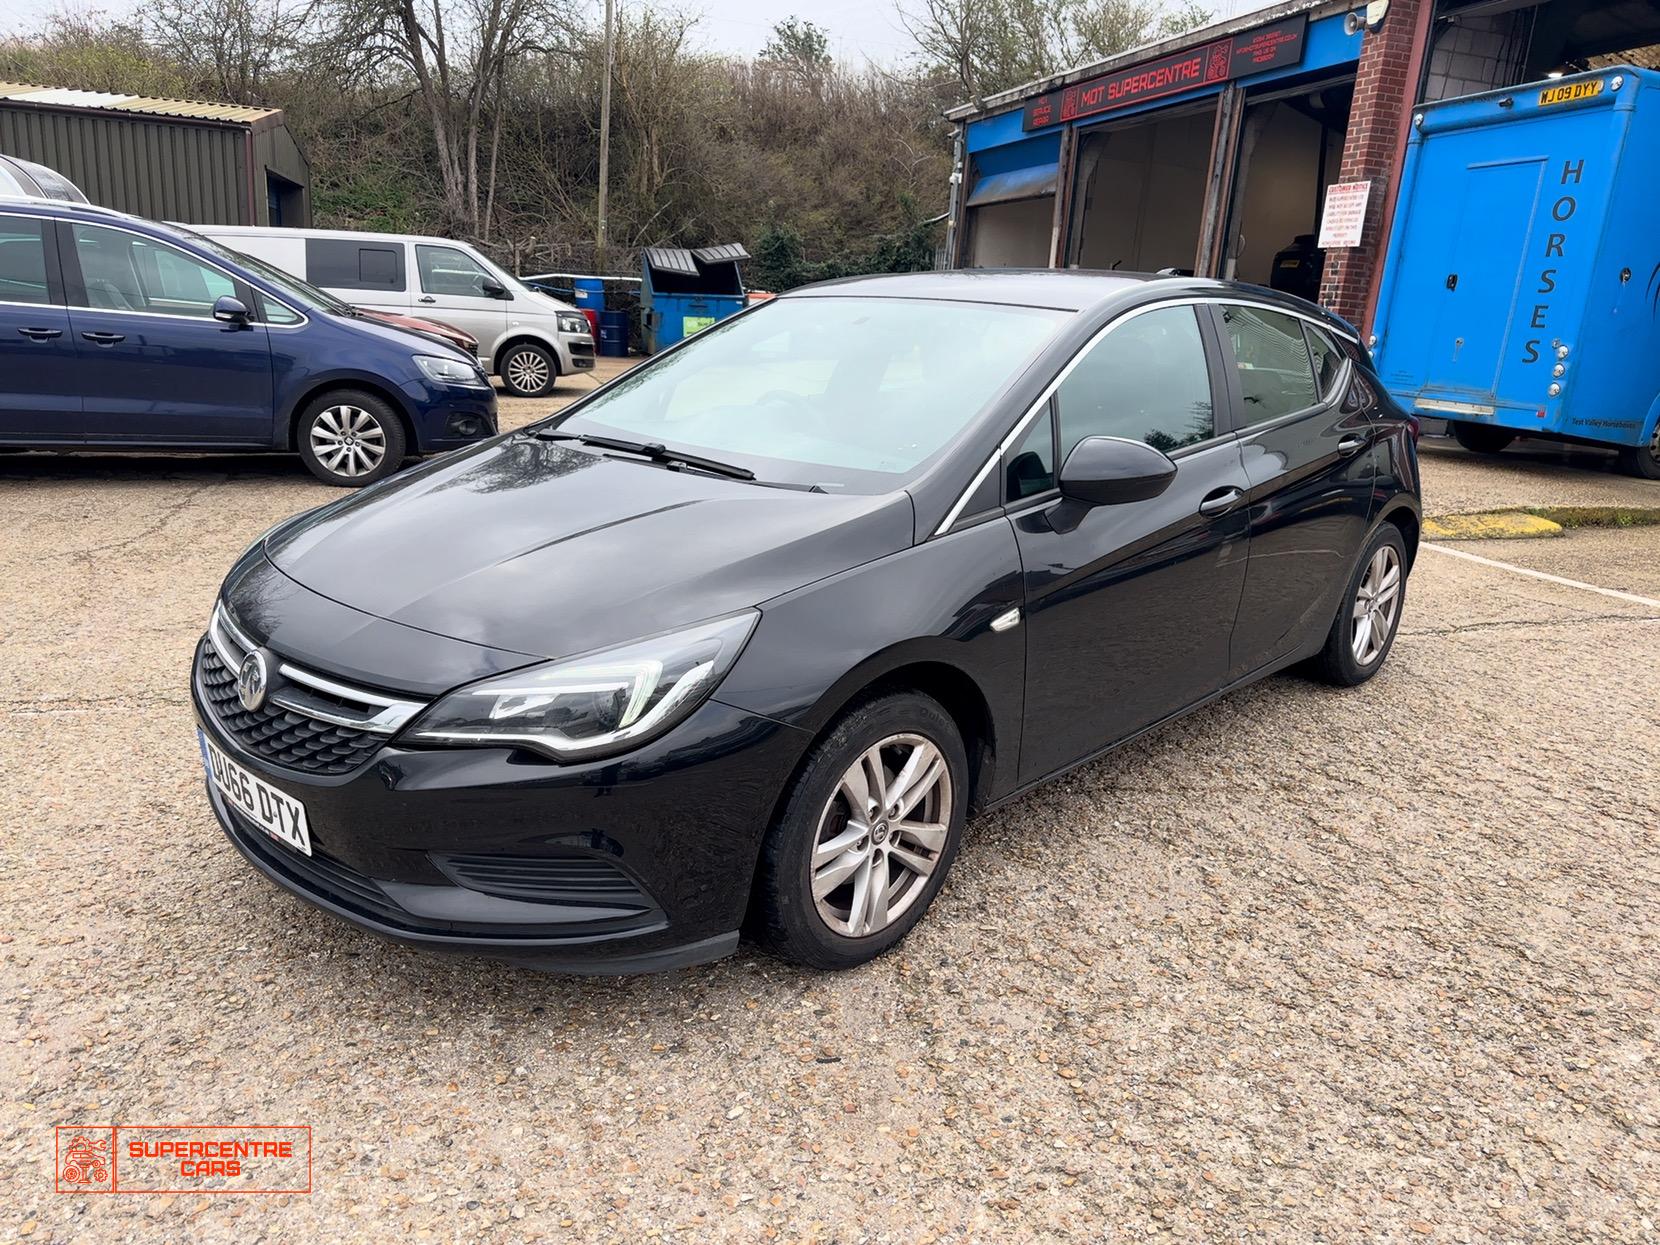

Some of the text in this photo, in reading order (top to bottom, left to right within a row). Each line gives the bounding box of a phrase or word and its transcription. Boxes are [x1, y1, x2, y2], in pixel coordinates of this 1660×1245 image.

[1081, 57, 1202, 107] MOT SUPERCENTRE
[1574, 80, 1598, 97] DYY
[1521, 159, 1585, 364] HORSES
[208, 743, 255, 811] DU66
[256, 782, 306, 846] DTX
